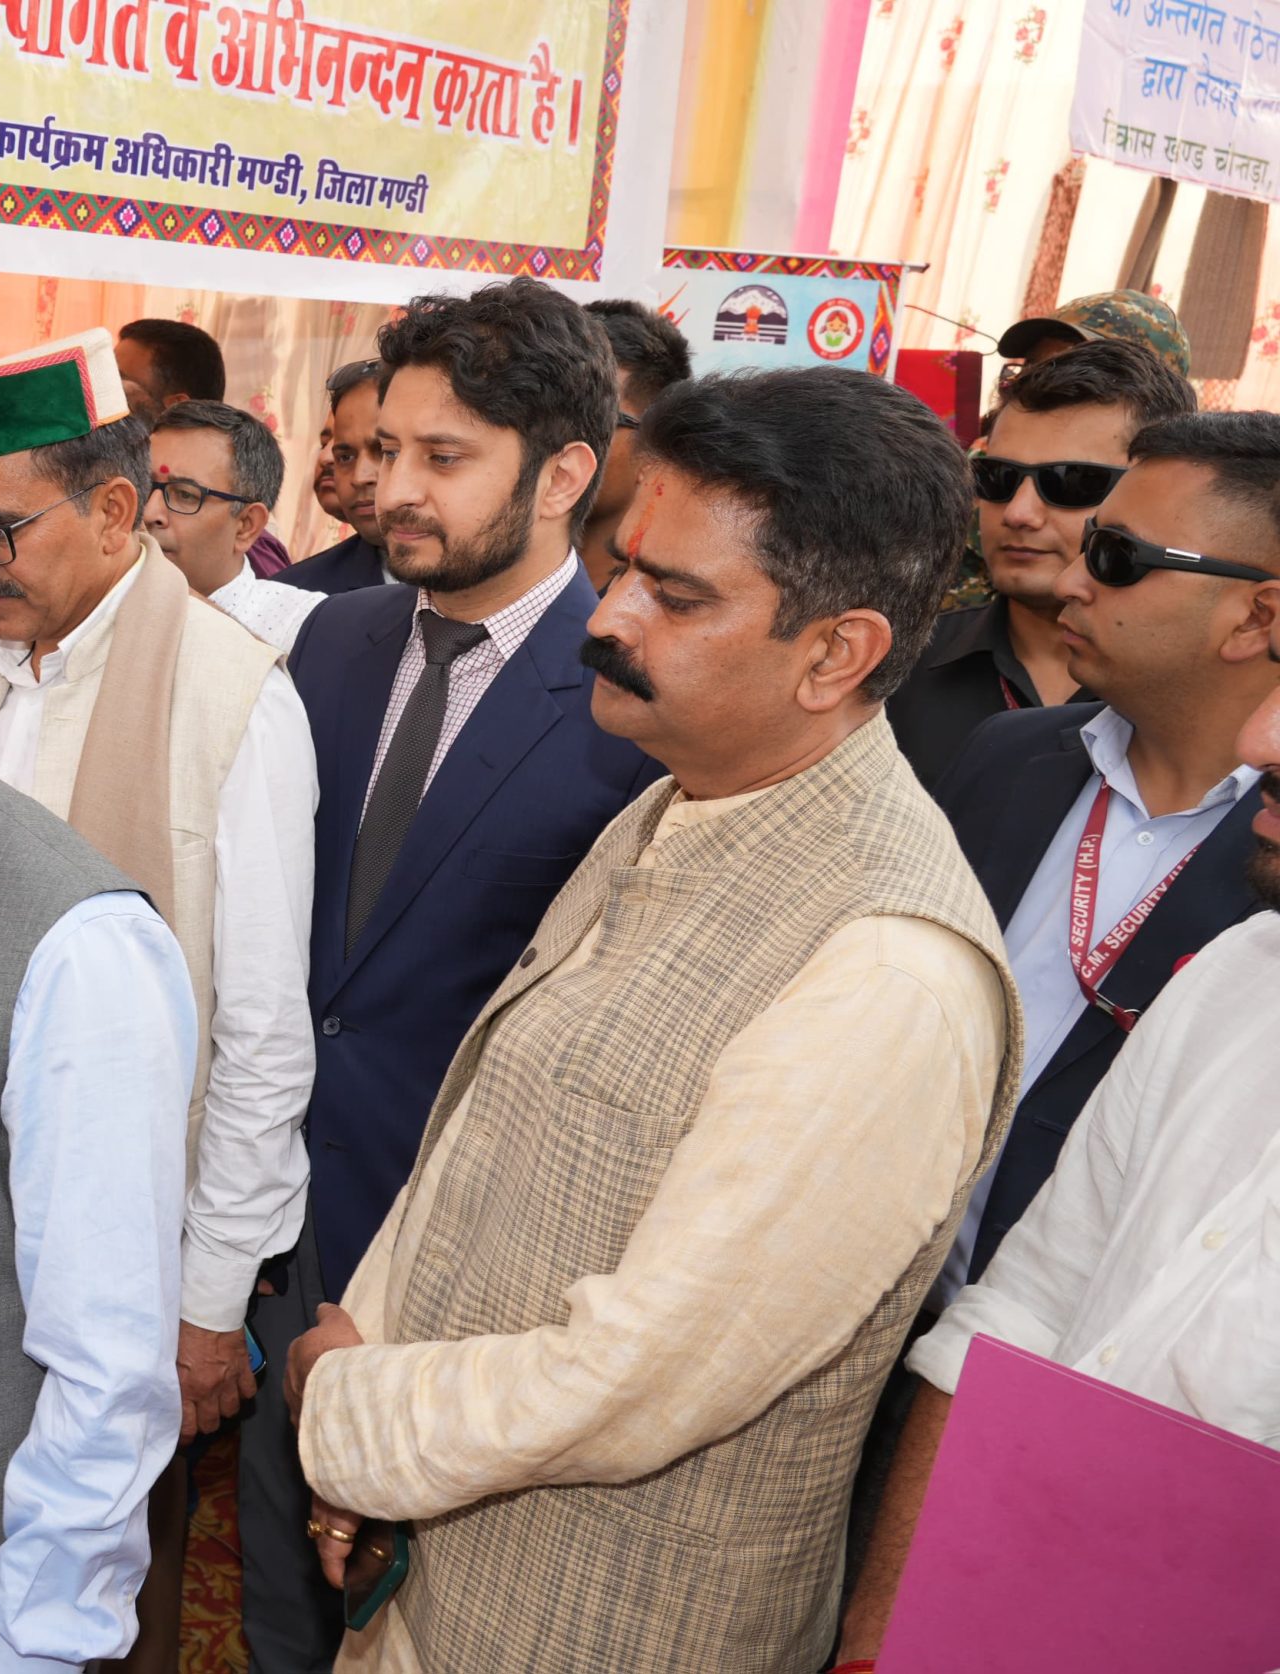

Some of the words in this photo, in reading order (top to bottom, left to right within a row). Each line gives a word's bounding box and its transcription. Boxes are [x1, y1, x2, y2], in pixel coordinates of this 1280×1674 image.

[212, 0, 433, 121] अभिनन्दन
[434, 50, 526, 138] करता
[1142, 57, 1188, 101] द्वारा
[111, 132, 234, 188] अधिकारी
[237, 153, 308, 204] मण्डी,
[315, 159, 380, 207] जिला
[378, 174, 429, 214] मण्डी
[1071, 872, 1093, 947] SECURITY
[1081, 950, 1110, 978] C.M.
[1104, 881, 1168, 949] SECURITY
